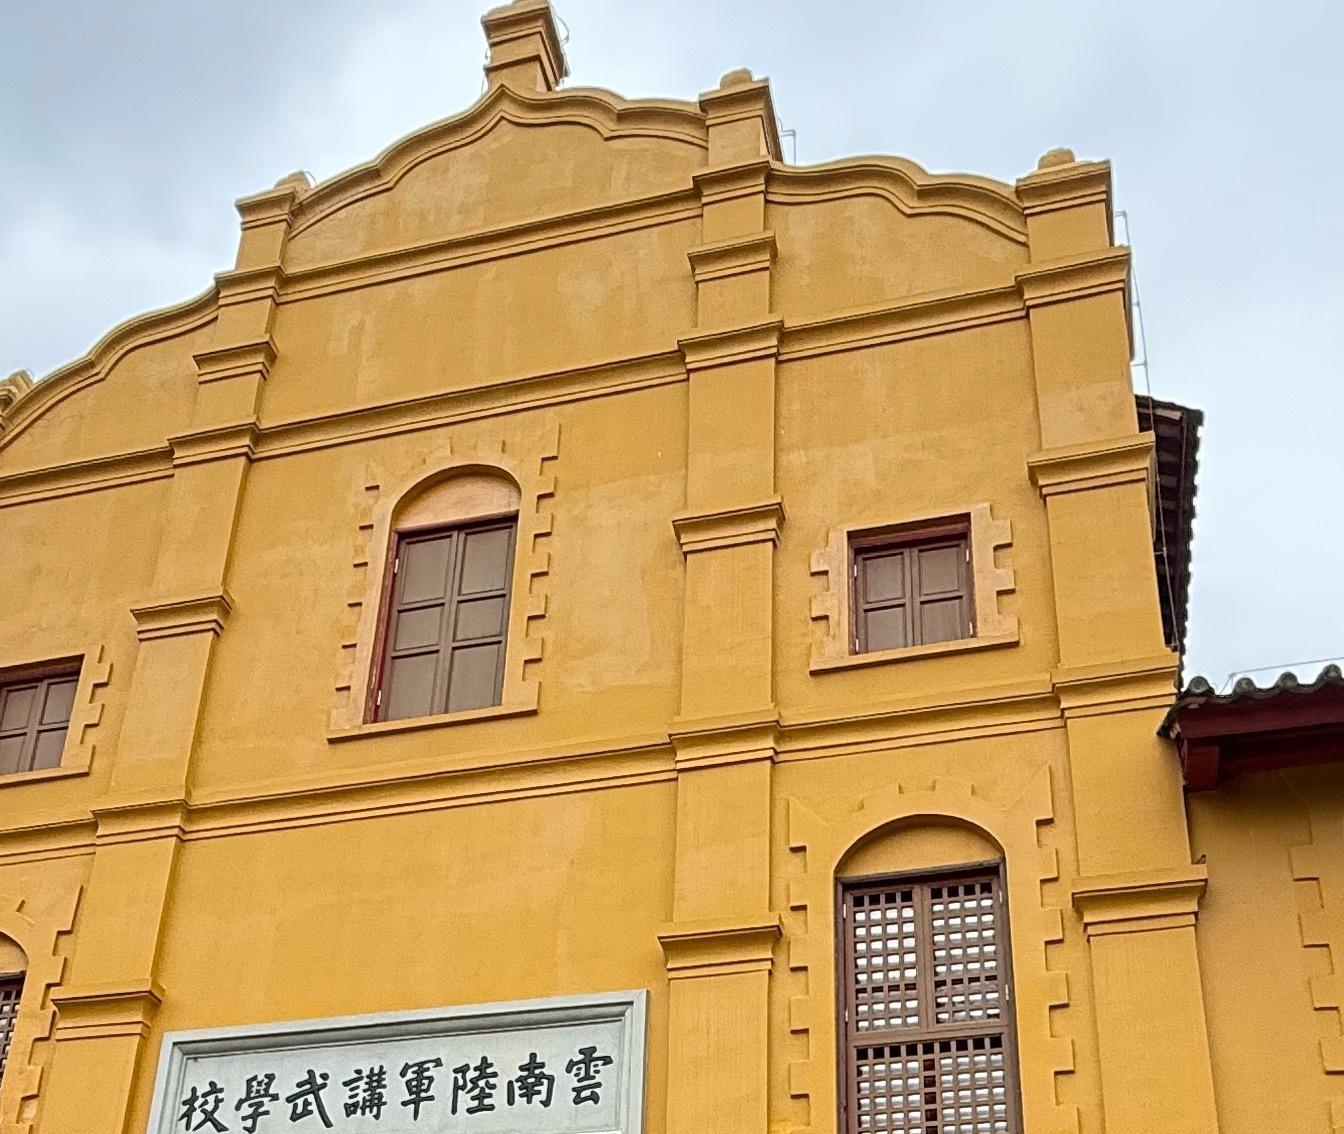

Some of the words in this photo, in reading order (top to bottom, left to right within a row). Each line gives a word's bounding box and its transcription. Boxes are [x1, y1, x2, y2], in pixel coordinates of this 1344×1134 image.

[179, 1044, 615, 1134] 雲南陸軍講武學校
